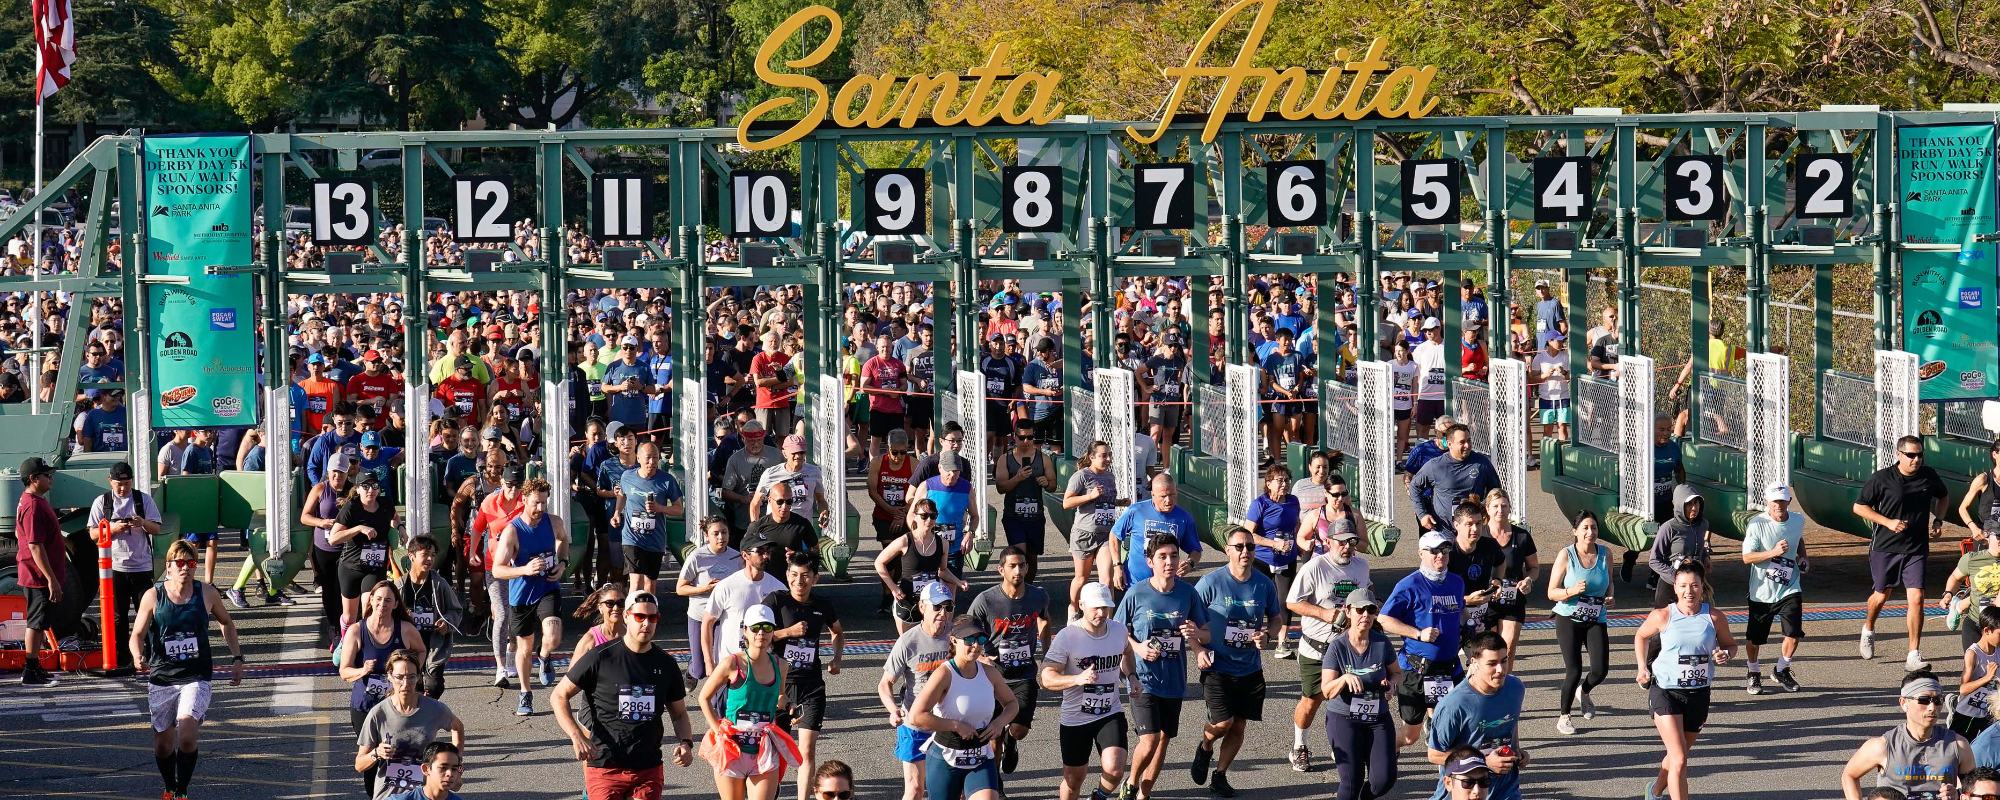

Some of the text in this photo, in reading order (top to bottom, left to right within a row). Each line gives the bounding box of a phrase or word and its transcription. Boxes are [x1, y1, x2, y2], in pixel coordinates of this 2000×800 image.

[736, 0, 1441, 152] Santa Anita
[1908, 136, 1984, 147] THANK YOU
[156, 147, 239, 159] THANK YOU
[1902, 148, 1992, 160] DERBY DAY 5K
[147, 160, 248, 171] DERBY DAY 5K
[1912, 160, 1939, 170] RUN
[1948, 159, 1984, 169] WALK
[158, 172, 188, 183] RUN
[199, 171, 238, 182] WALK
[1910, 170, 1984, 182] SPONSORS!
[157, 184, 238, 195] SPONSORS!
[1409, 163, 1451, 219] 5
[1542, 161, 1584, 216] 4
[1675, 160, 1714, 215] 3
[1805, 158, 1844, 214] 2
[1143, 168, 1185, 224] 7
[1277, 165, 1317, 221] 6
[734, 175, 786, 233] 10
[875, 174, 915, 229] 9
[1013, 171, 1052, 227] 8
[315, 182, 370, 240] 13
[456, 180, 510, 237] 12
[603, 178, 641, 235] 11
[160, 348, 198, 357] GOLDEN ROAD
[886, 493, 900, 501] 578
[635, 522, 651, 530] 916
[365, 552, 381, 560] 686
[1773, 568, 1788, 578] 756
[1576, 606, 1598, 616] 4395
[1231, 632, 1249, 642] 796
[168, 643, 194, 654] 4144
[786, 650, 812, 662] 3951
[1002, 651, 1028, 662] 3676
[1682, 669, 1706, 679] 1392
[1430, 686, 1448, 694] 333
[622, 701, 651, 712] 2864
[1085, 697, 1110, 708] 3715
[1357, 703, 1374, 713] 797
[963, 748, 982, 757] 448
[396, 768, 413, 779] 92
